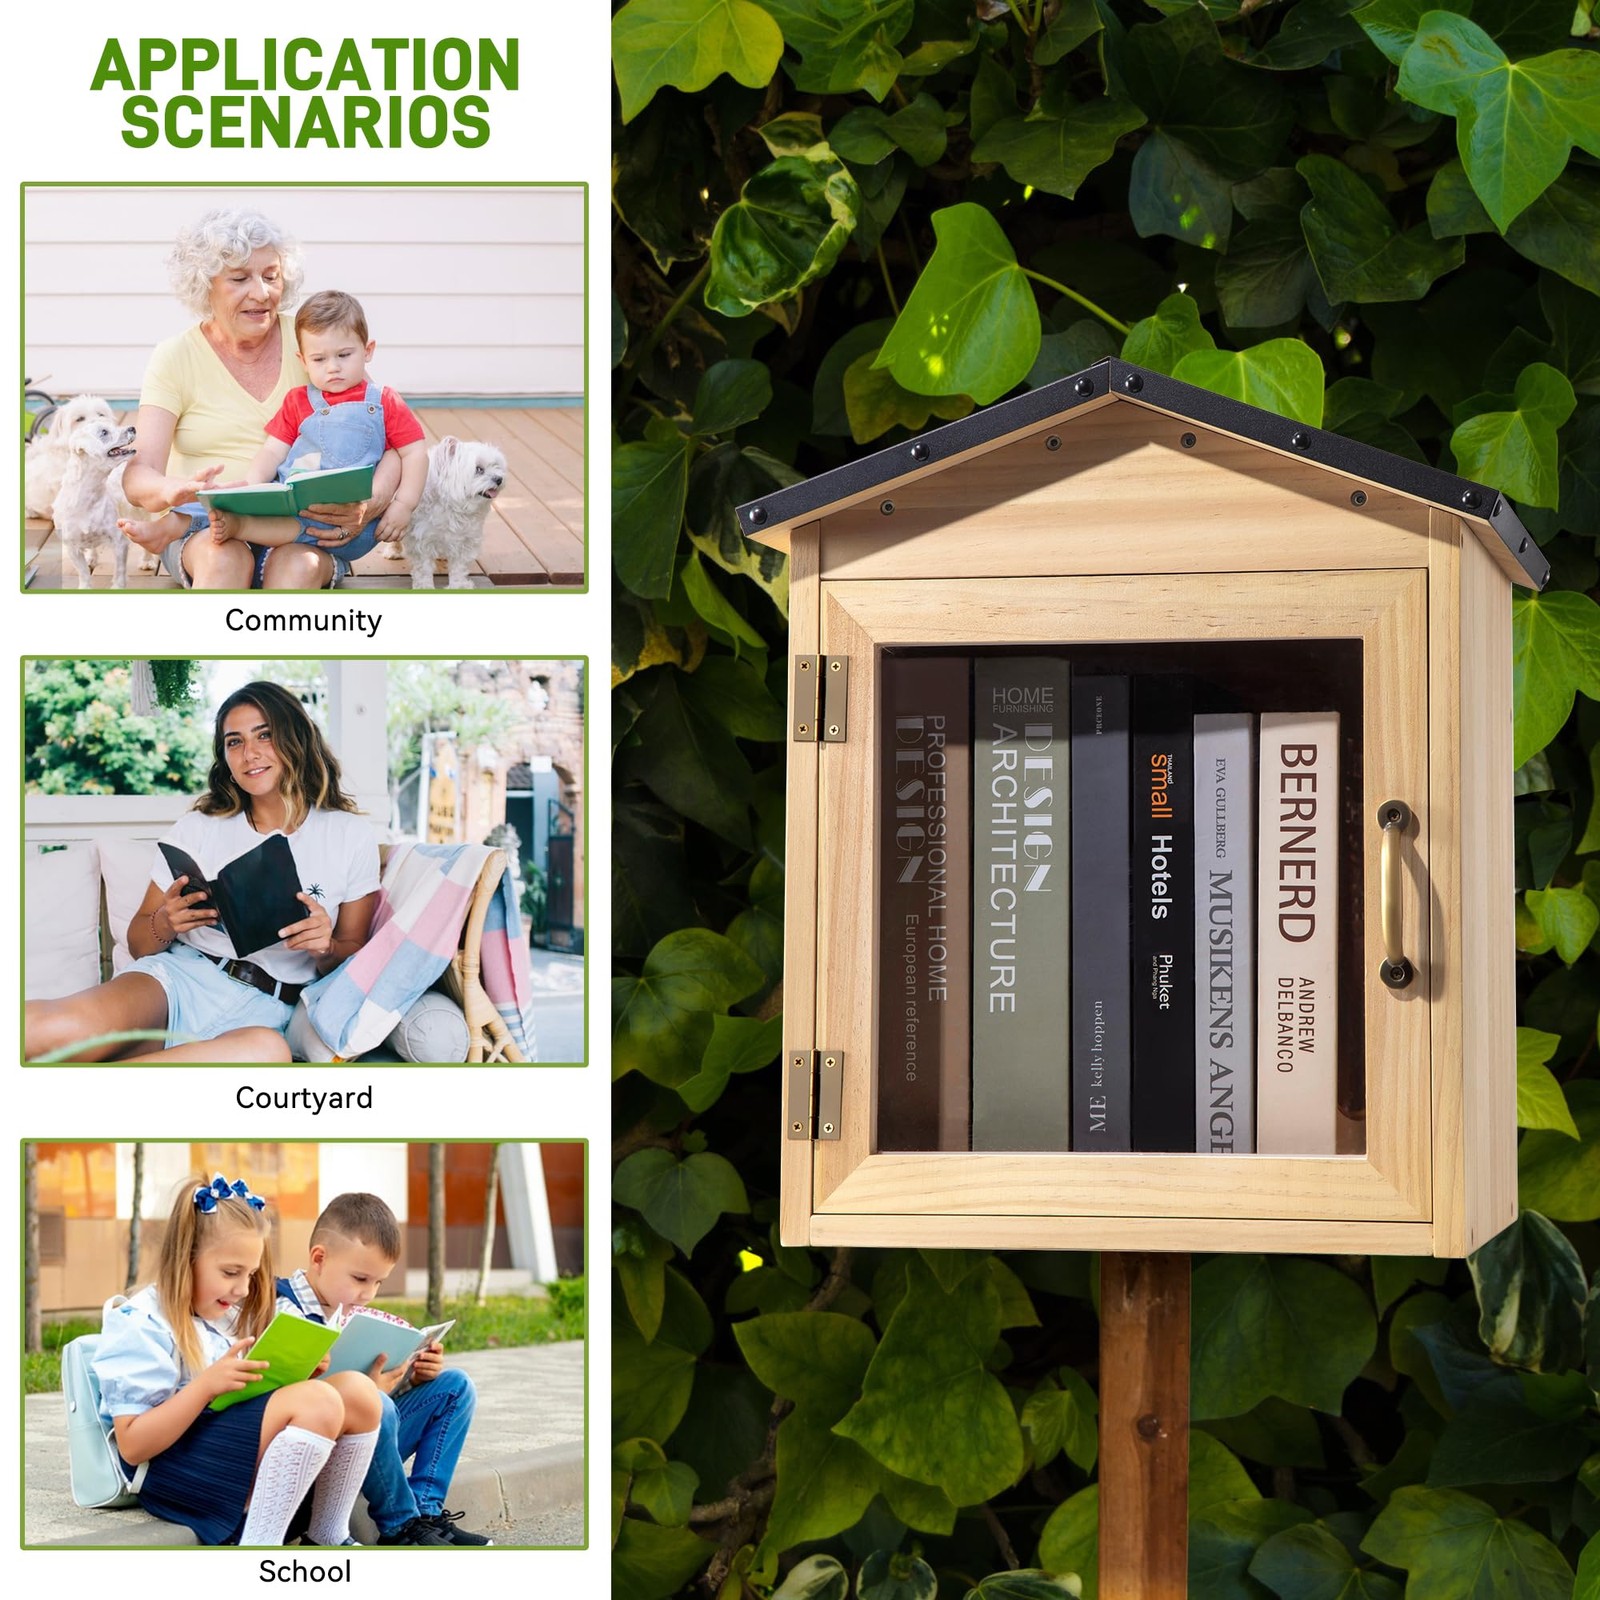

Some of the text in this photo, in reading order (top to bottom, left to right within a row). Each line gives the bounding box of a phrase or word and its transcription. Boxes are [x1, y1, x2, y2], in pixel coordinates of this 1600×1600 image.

[992, 704, 1054, 714] FURNISHING
[993, 687, 1054, 704] HOME
[896, 716, 925, 883] DESIGN
[927, 715, 947, 1002] PROFESSIONAL HOME
[989, 723, 1018, 1013] ARCHITECTURE
[1023, 723, 1053, 892] DESIGN
[1151, 753, 1173, 919] small Hotels
[1215, 758, 1226, 859] EVA GULLBERG
[1278, 744, 1317, 943] BERNERD
[903, 914, 920, 1082] European reference
[1159, 954, 1173, 1010] Phuket
[1209, 869, 1234, 1049] MUSIKENS
[1277, 977, 1294, 1073] DELBANCO
[1298, 977, 1315, 1054] ANDREW
[1089, 1000, 1107, 1132] ME kelly hoppen
